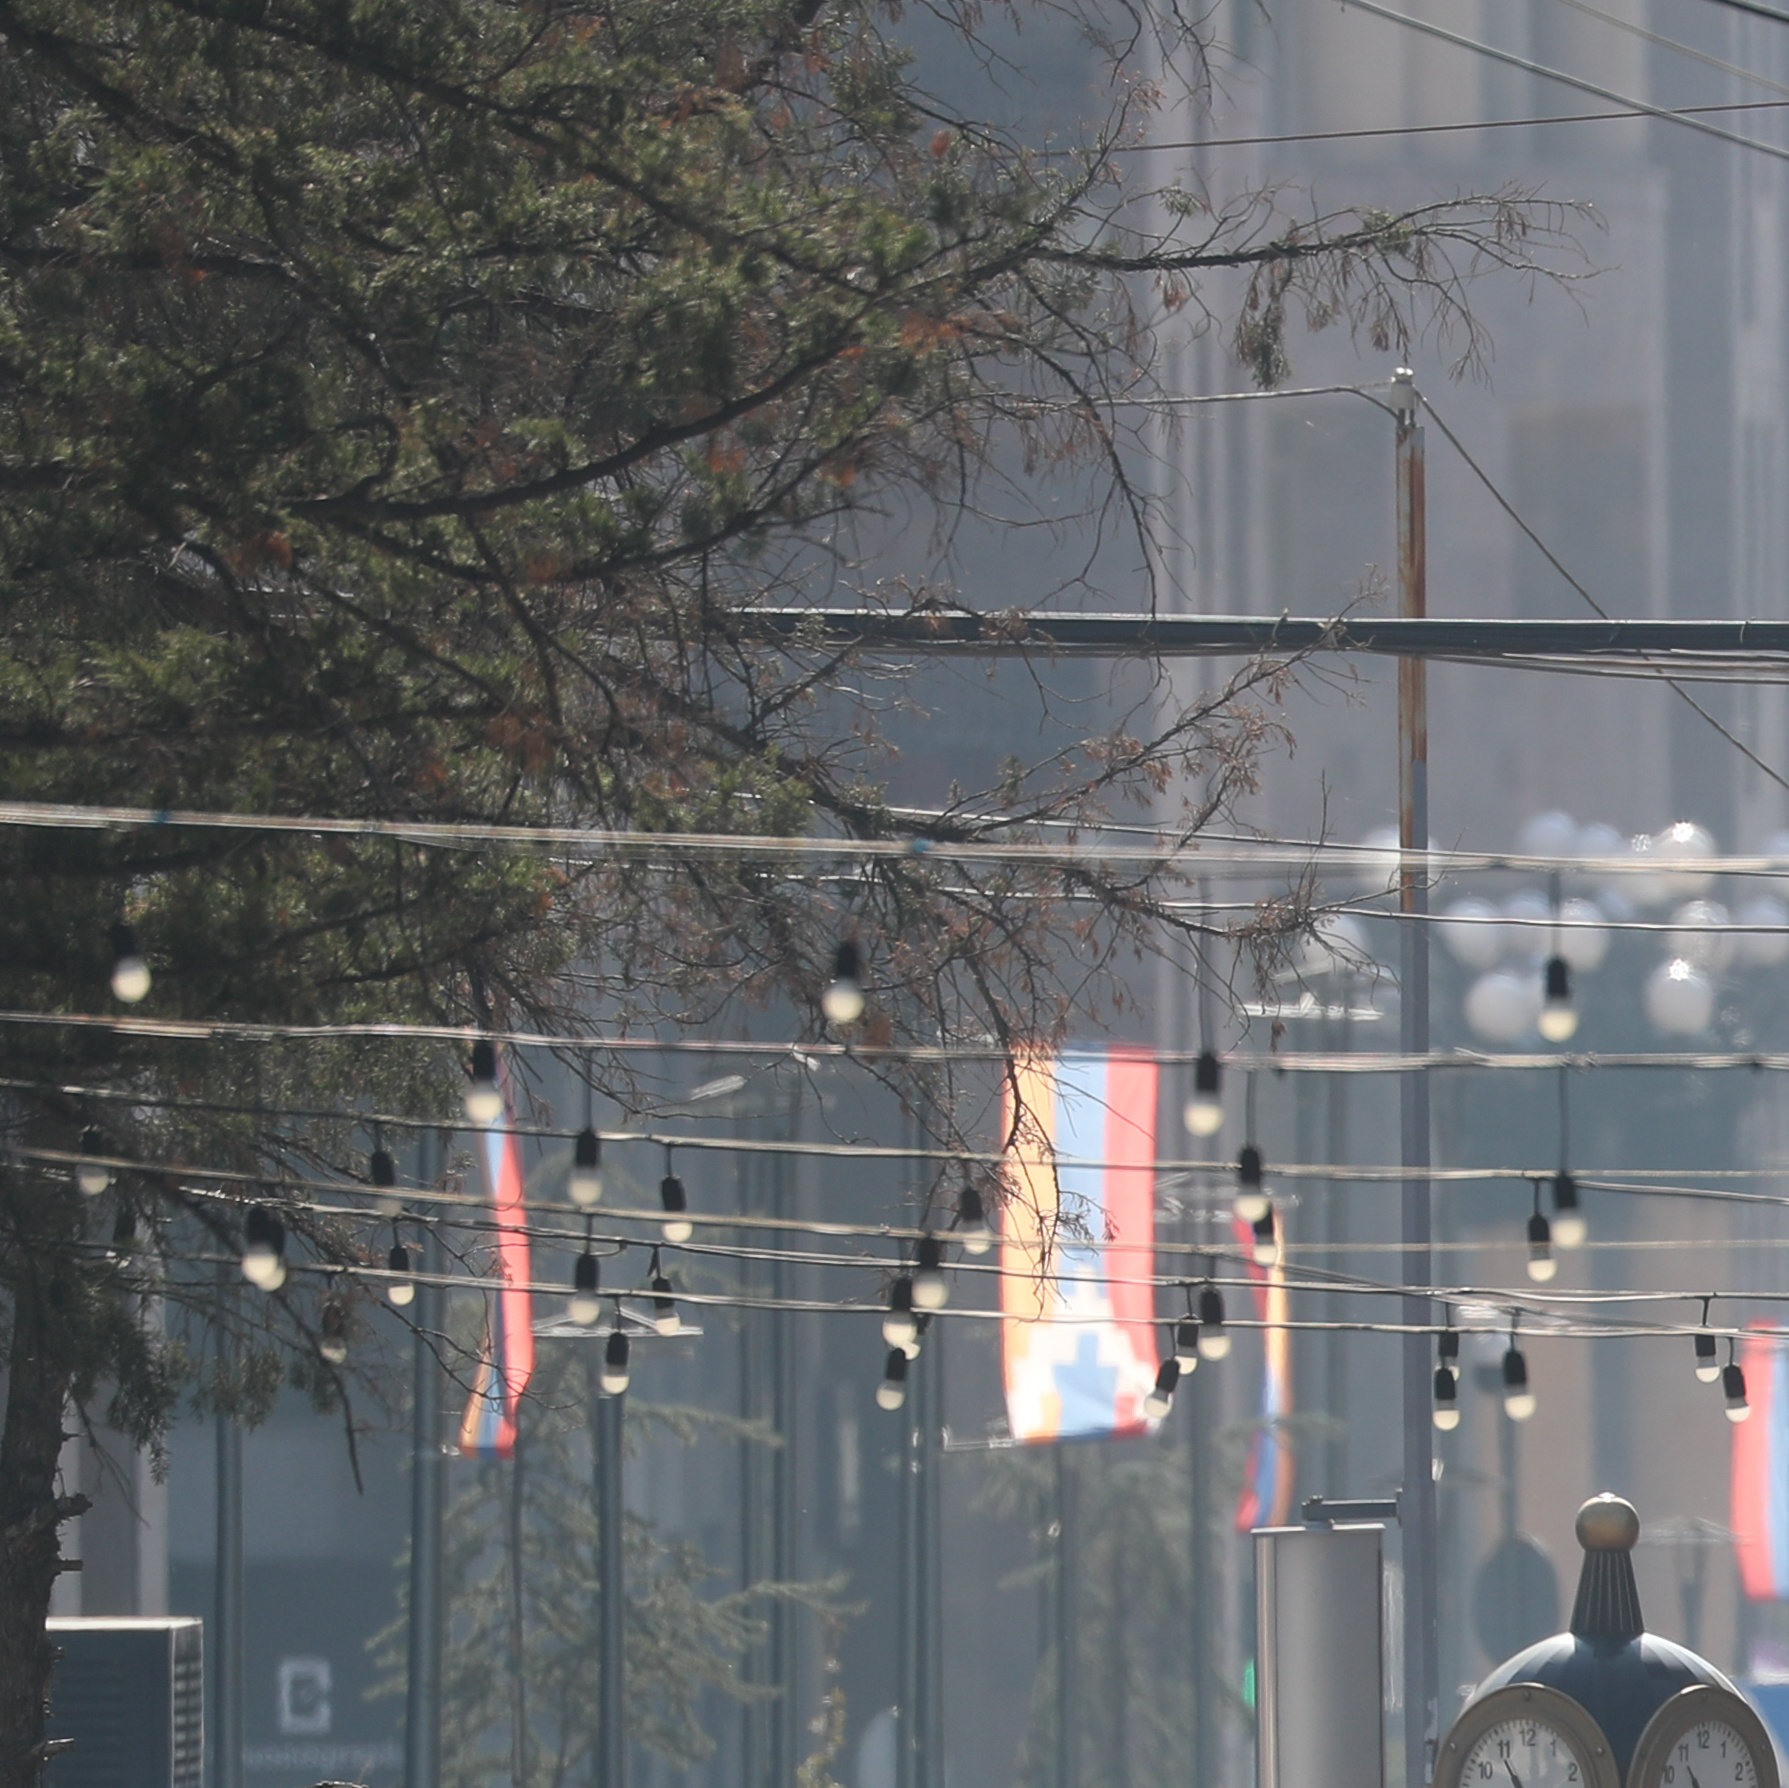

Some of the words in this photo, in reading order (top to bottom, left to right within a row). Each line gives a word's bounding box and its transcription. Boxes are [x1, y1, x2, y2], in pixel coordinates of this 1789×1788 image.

[1518, 1728, 1536, 1747] 12
[1697, 1729, 1711, 1748] 12
[1497, 1739, 1513, 1758] 11
[1549, 1738, 1558, 1757] 1
[1678, 1743, 1690, 1762] 11
[1720, 1739, 1728, 1758] 1
[1478, 1761, 1494, 1780] 10
[1567, 1762, 1578, 1782] 2
[1734, 1762, 1744, 1782] 2
